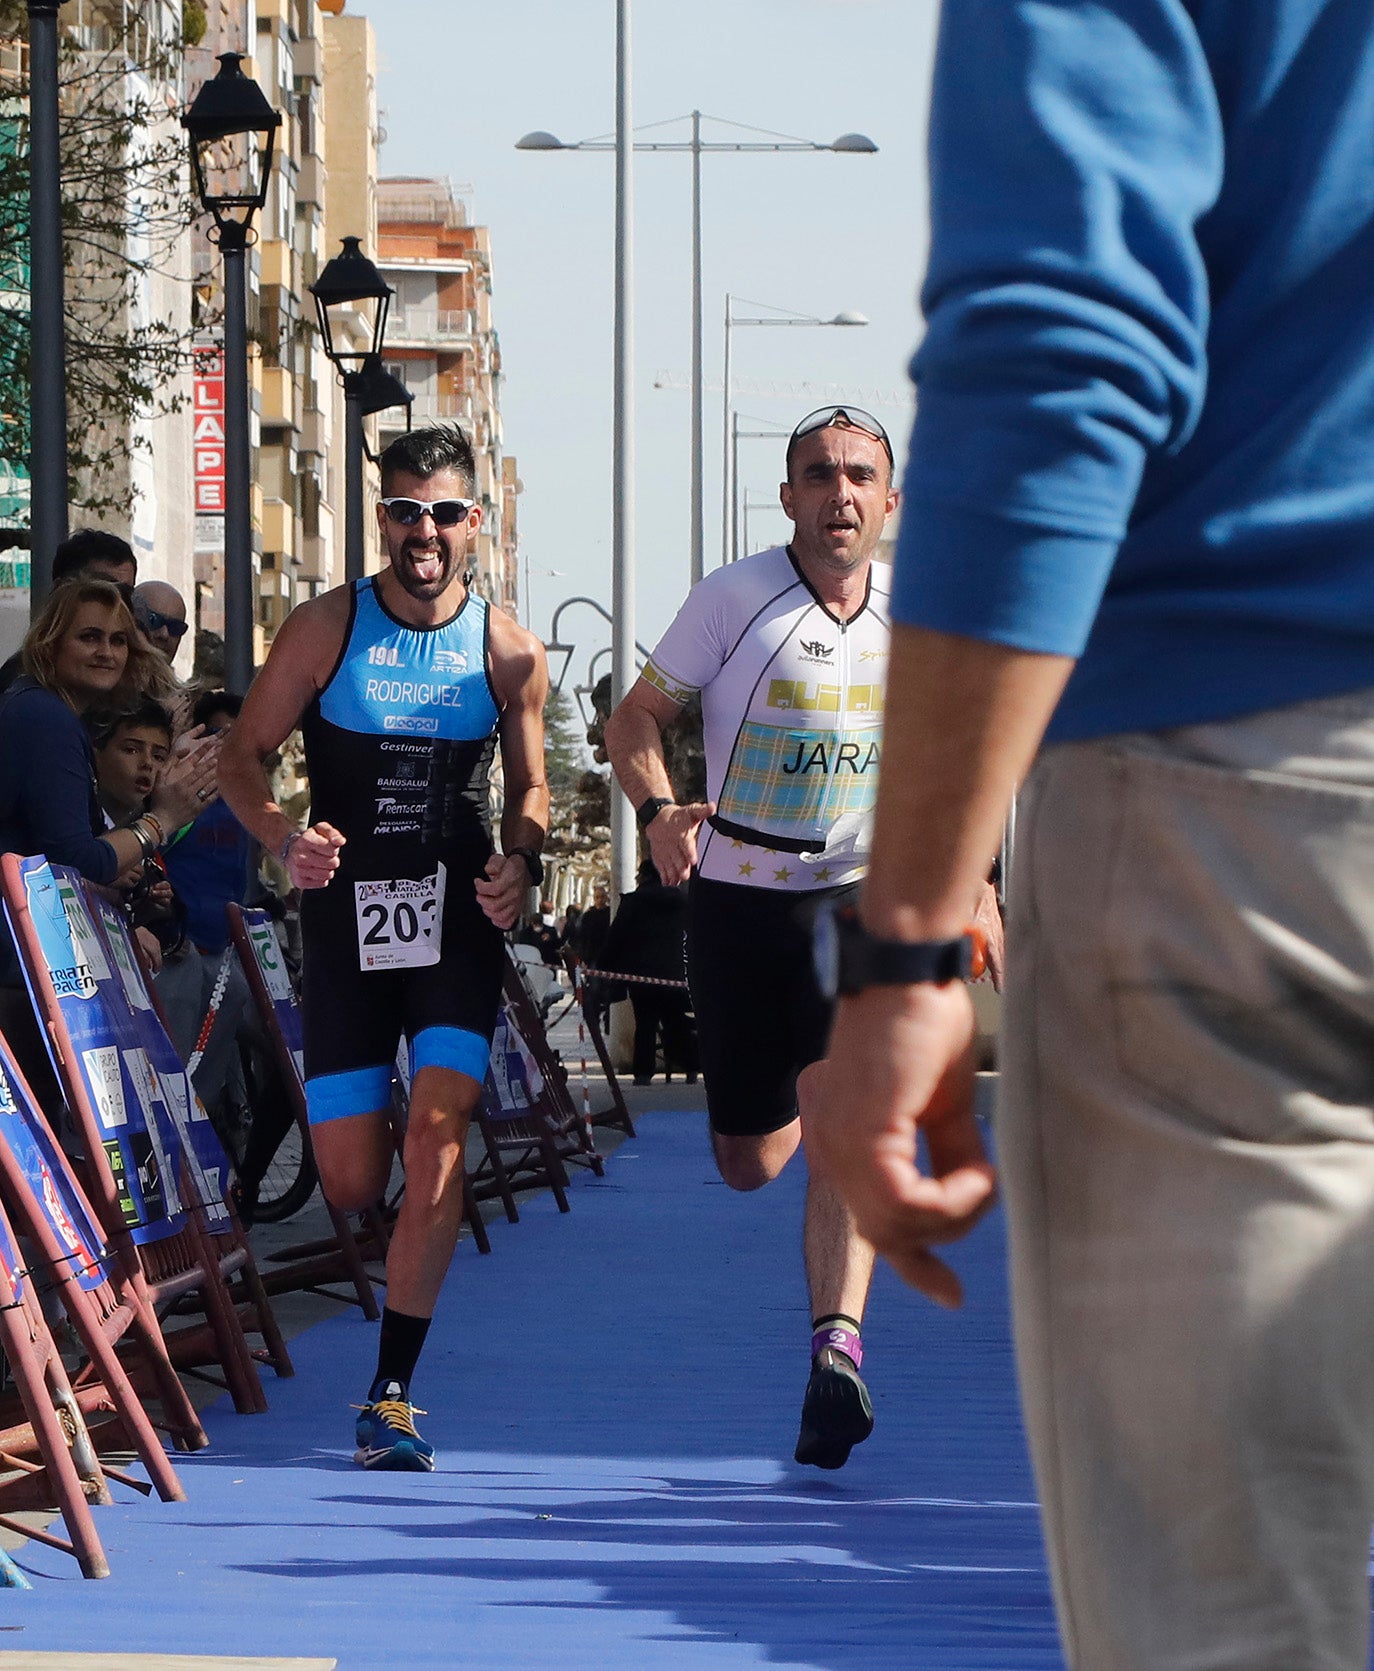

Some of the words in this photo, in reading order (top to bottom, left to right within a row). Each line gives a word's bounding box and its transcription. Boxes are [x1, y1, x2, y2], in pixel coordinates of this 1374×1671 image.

[365, 679, 462, 707] RODRIGUEZ
[380, 742, 434, 753] Gestinver
[783, 742, 881, 774] JARA
[384, 890, 434, 900] CASTILLA
